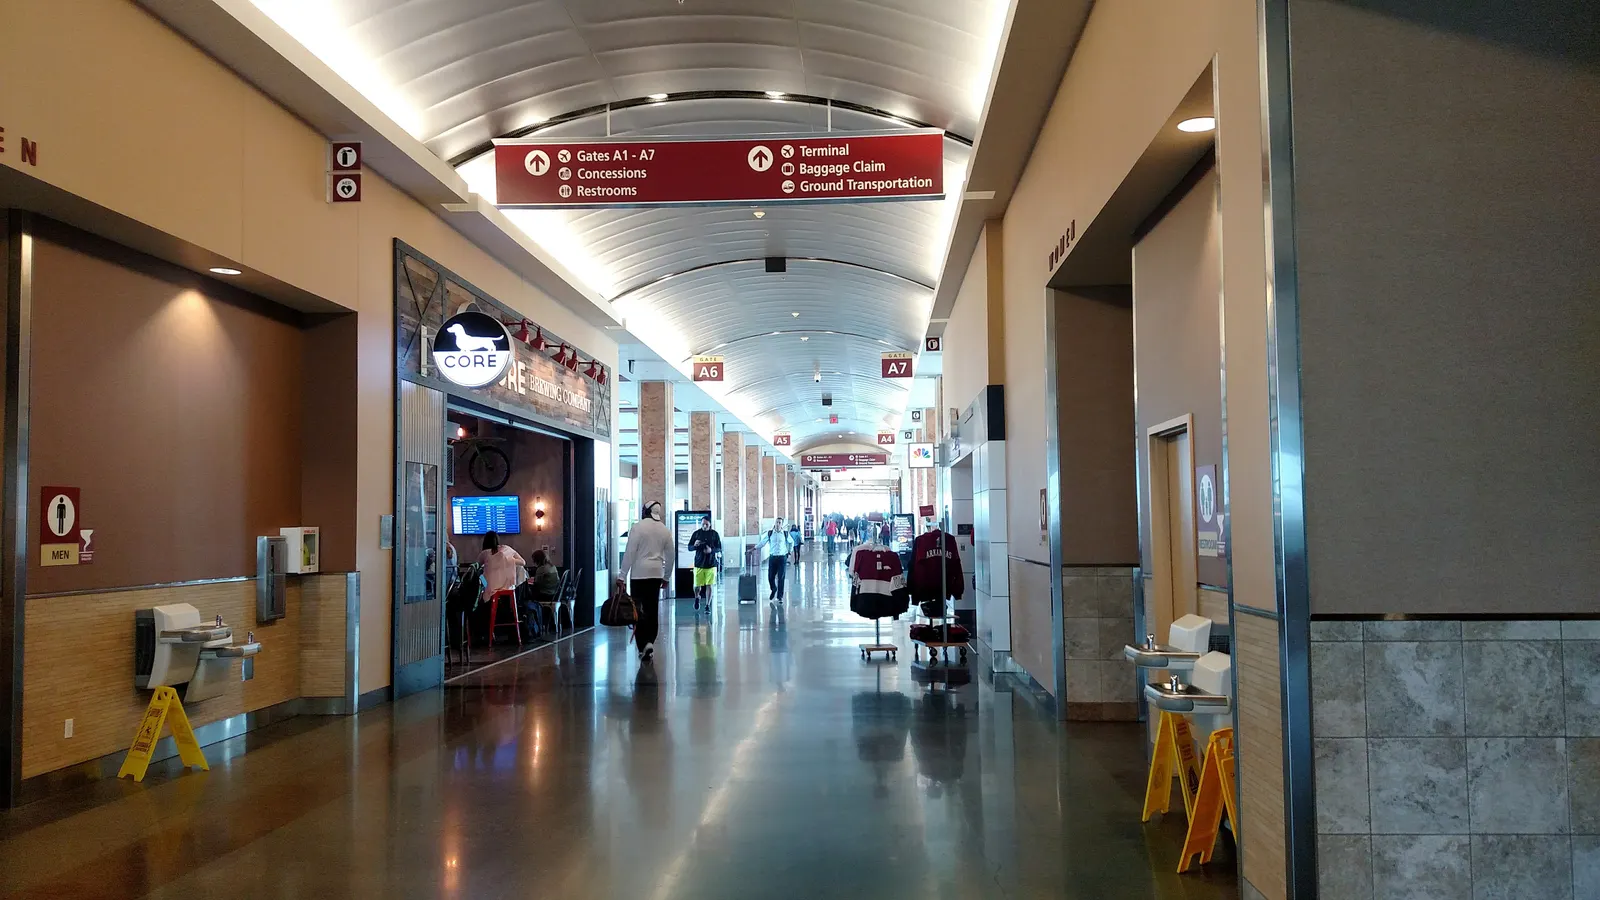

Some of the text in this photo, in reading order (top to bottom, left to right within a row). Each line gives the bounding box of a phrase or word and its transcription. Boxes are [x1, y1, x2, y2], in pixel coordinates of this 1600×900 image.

[577, 150, 610, 162] Gates
[613, 149, 628, 161] A1
[639, 149, 655, 161] A7
[800, 144, 850, 157] Terminal
[577, 168, 647, 180] Concessions
[800, 160, 886, 176] Baggage Claim
[800, 176, 932, 192] Ground Transportation
[577, 186, 637, 197] Restrooms
[444, 354, 496, 368] CORE
[699, 366, 718, 378] A6
[888, 362, 906, 374] A7
[530, 374, 591, 413] BREWING COMPANY
[776, 436, 788, 444] A5
[880, 435, 892, 443] A4
[52, 550, 70, 560] MEN
